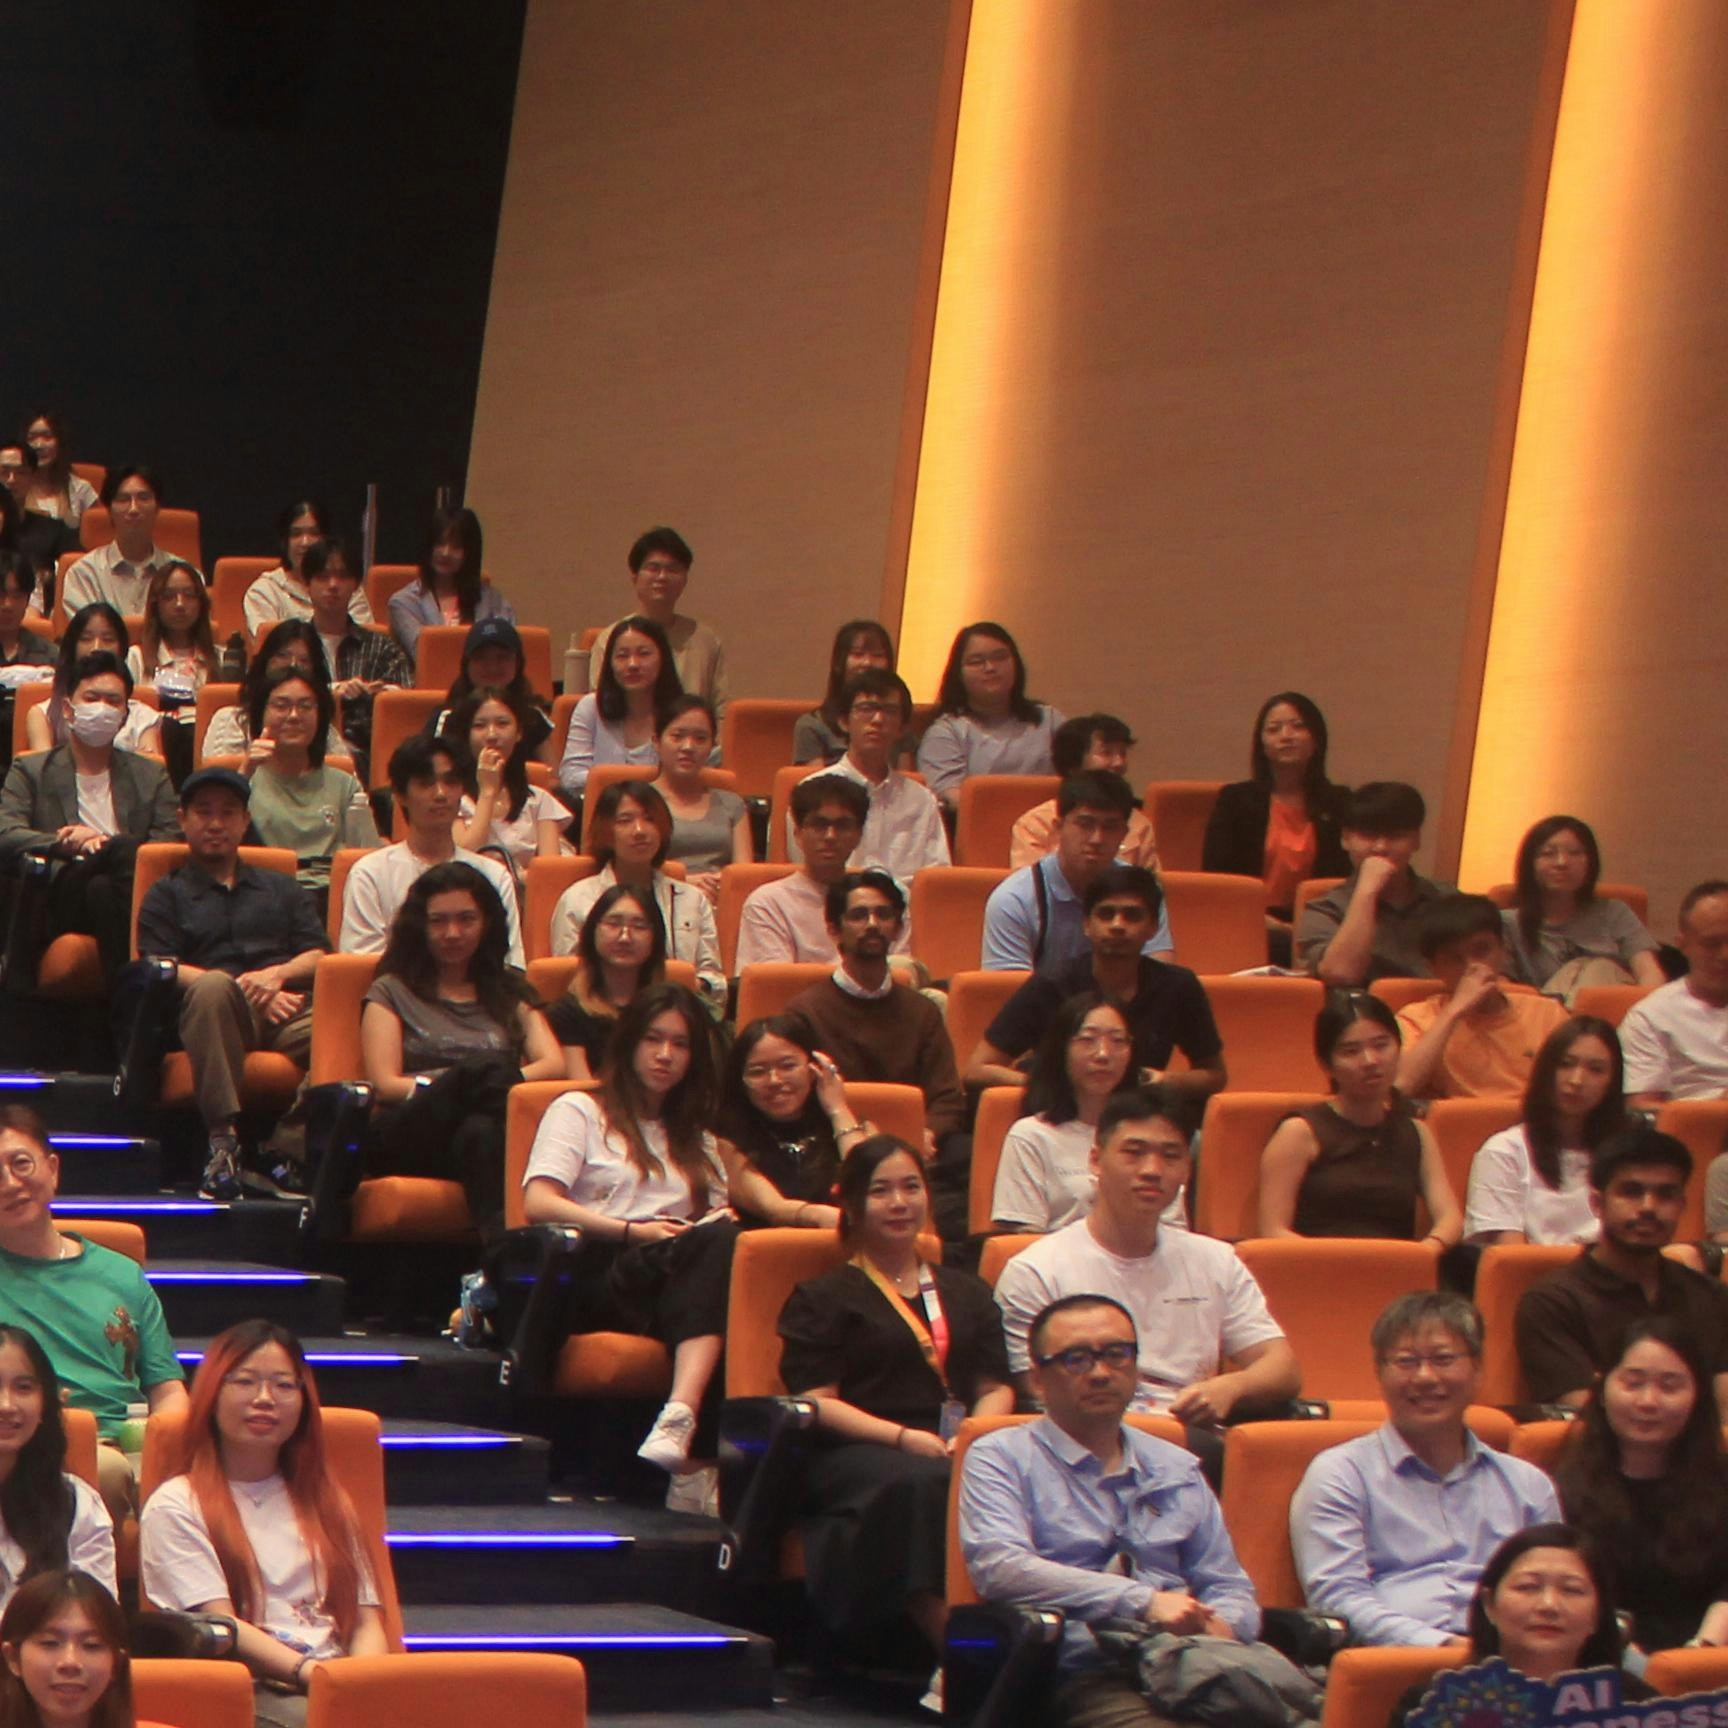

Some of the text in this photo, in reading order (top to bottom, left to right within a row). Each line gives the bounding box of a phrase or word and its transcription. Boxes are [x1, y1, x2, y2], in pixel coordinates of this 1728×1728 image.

[499, 1359, 511, 1385] E
[718, 1543, 731, 1571] D
[1552, 1680, 1613, 1716] AI
